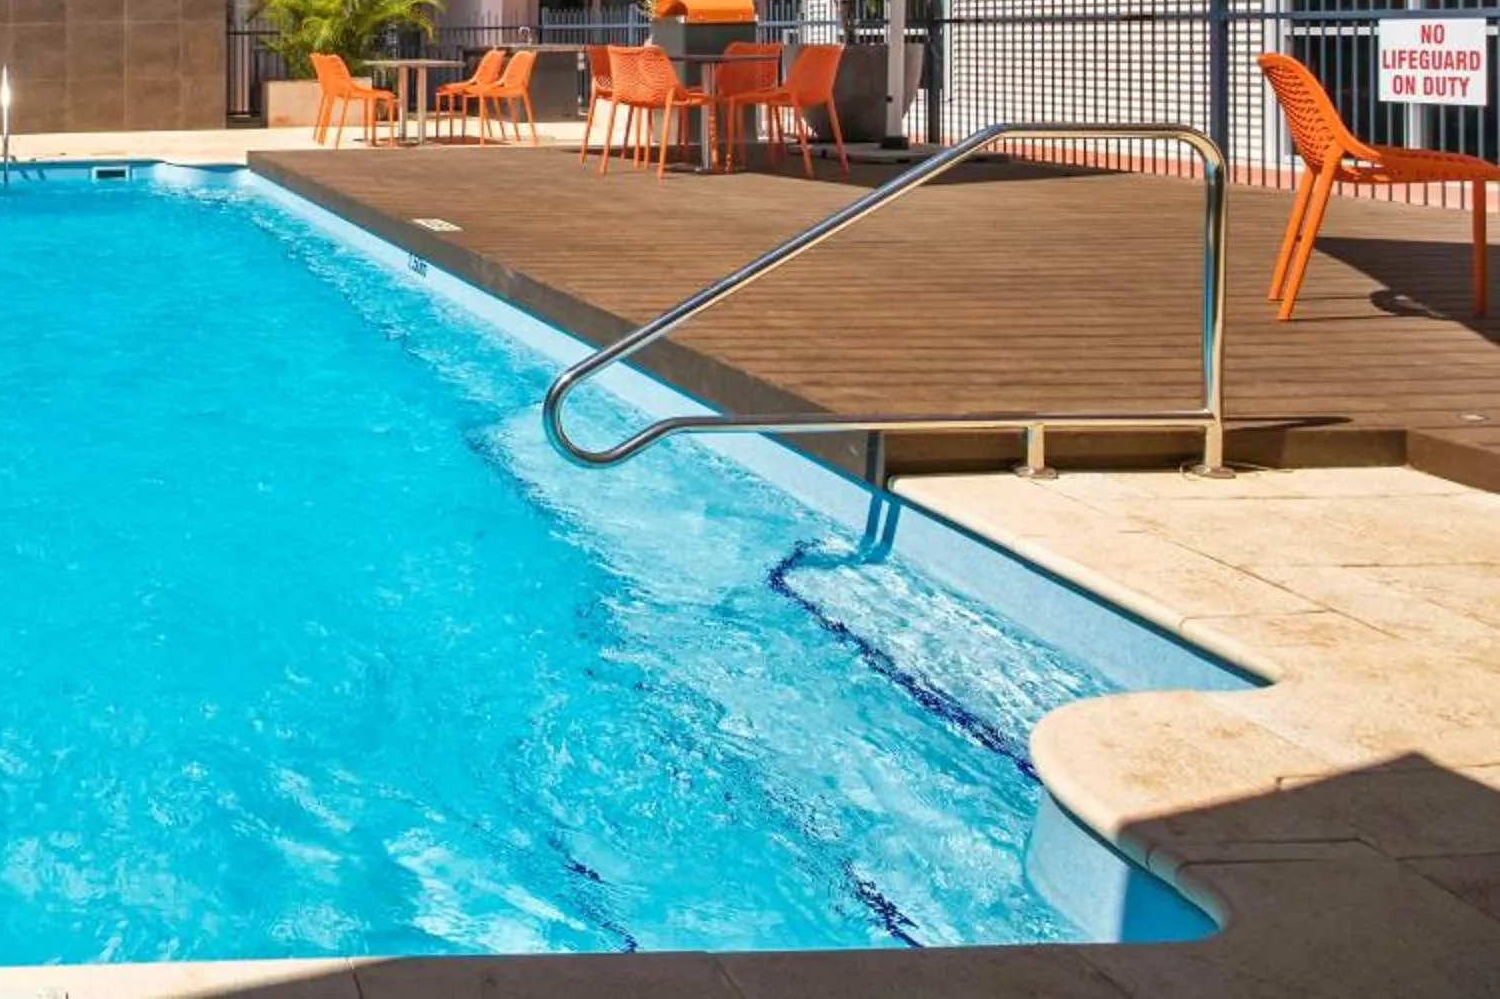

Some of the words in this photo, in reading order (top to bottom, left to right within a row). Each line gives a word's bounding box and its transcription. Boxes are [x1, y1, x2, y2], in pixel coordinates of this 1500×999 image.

[1420, 24, 1445, 44] NO
[1382, 49, 1481, 71] LIFEGUARD
[1392, 75, 1416, 95] ON
[1423, 76, 1470, 97] DUTY
